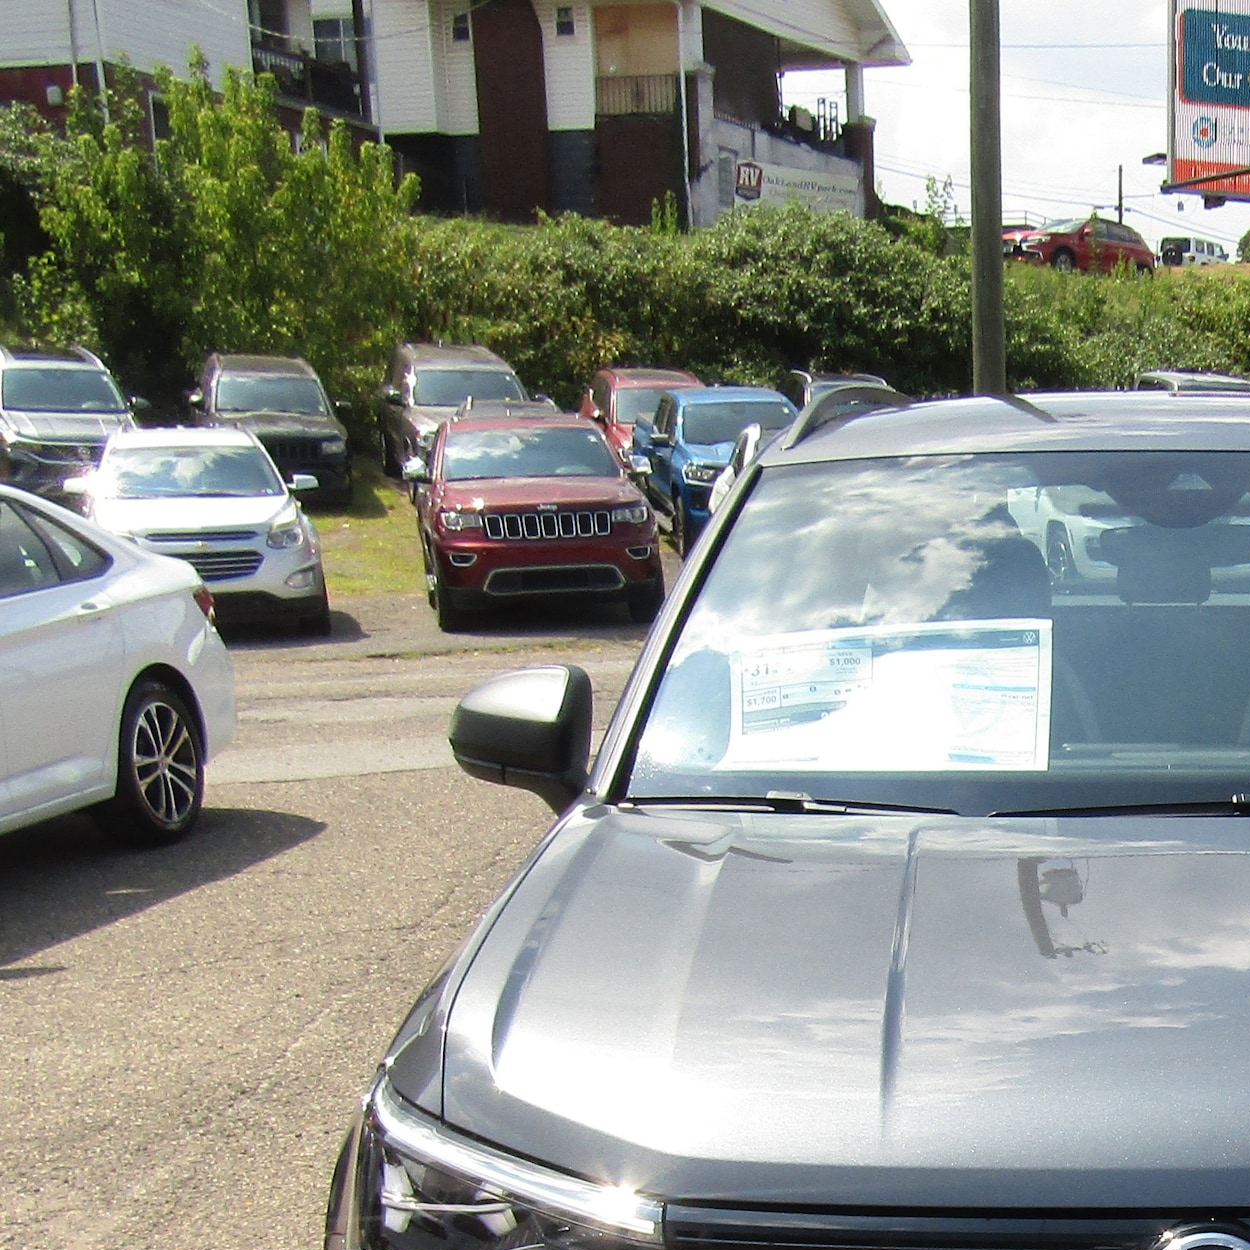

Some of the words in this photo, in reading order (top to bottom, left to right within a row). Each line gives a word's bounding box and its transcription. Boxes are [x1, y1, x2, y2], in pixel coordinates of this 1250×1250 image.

[1203, 62, 1243, 90] Our
[739, 166, 760, 187] RV
[829, 657, 861, 667] $1,000
[746, 695, 777, 707] $1,700
